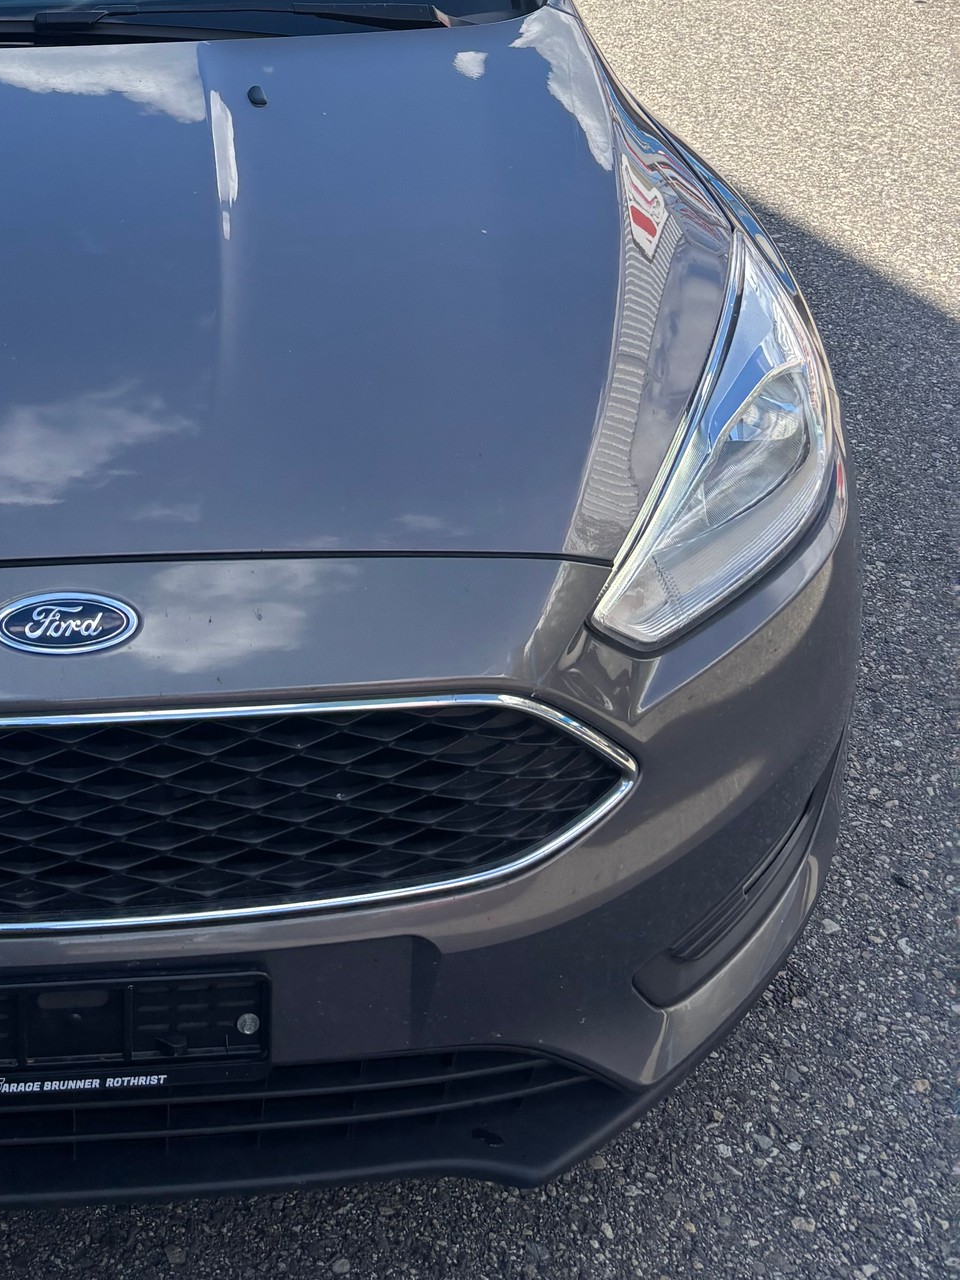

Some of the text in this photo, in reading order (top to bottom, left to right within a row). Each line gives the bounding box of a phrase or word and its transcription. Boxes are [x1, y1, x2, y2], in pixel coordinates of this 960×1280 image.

[24, 605, 103, 639] Ford
[43, 1079, 100, 1091] BRUNNER
[105, 1074, 168, 1087] ROTHRIST
